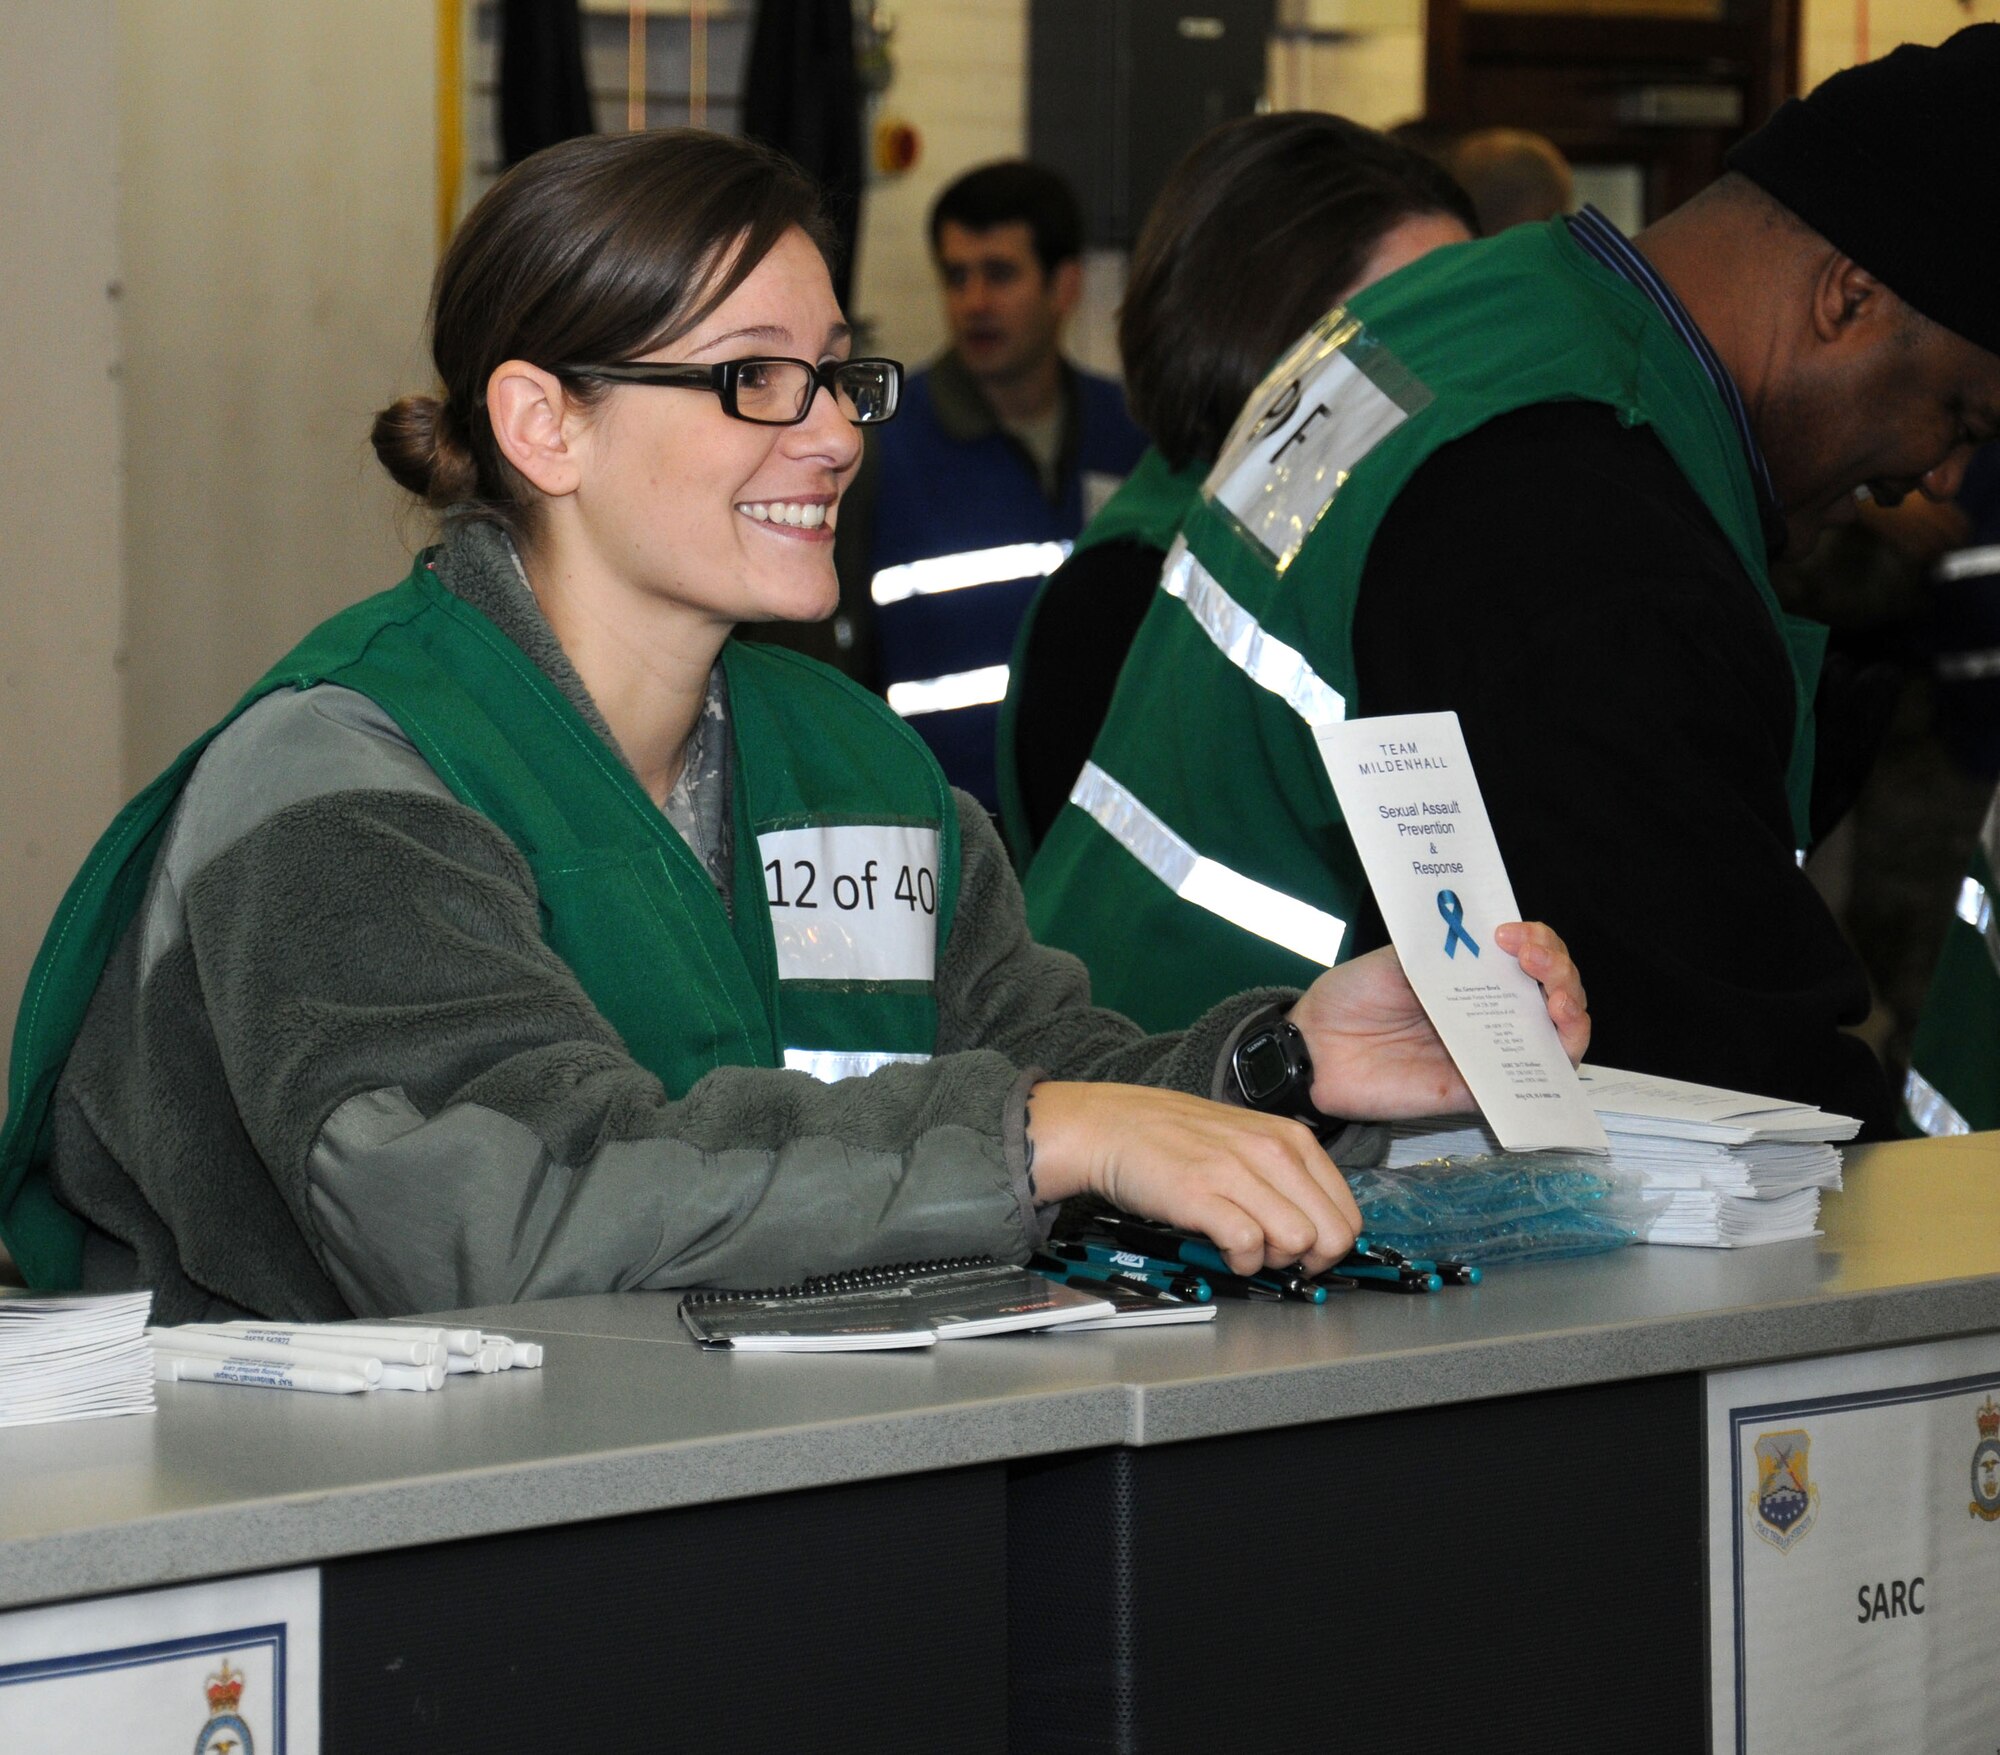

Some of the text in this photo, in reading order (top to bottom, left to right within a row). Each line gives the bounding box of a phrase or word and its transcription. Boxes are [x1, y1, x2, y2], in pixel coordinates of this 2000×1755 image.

[1379, 741, 1418, 757] TEAM
[1359, 757, 1448, 775] MILDENHALL
[1378, 800, 1461, 820] Sexual Assault
[1397, 821, 1455, 837] Prevention
[1429, 842, 1439, 855] &
[1412, 860, 1464, 878] Response
[764, 858, 936, 915] 12 of 40
[1857, 1577, 1925, 1624] SARC
